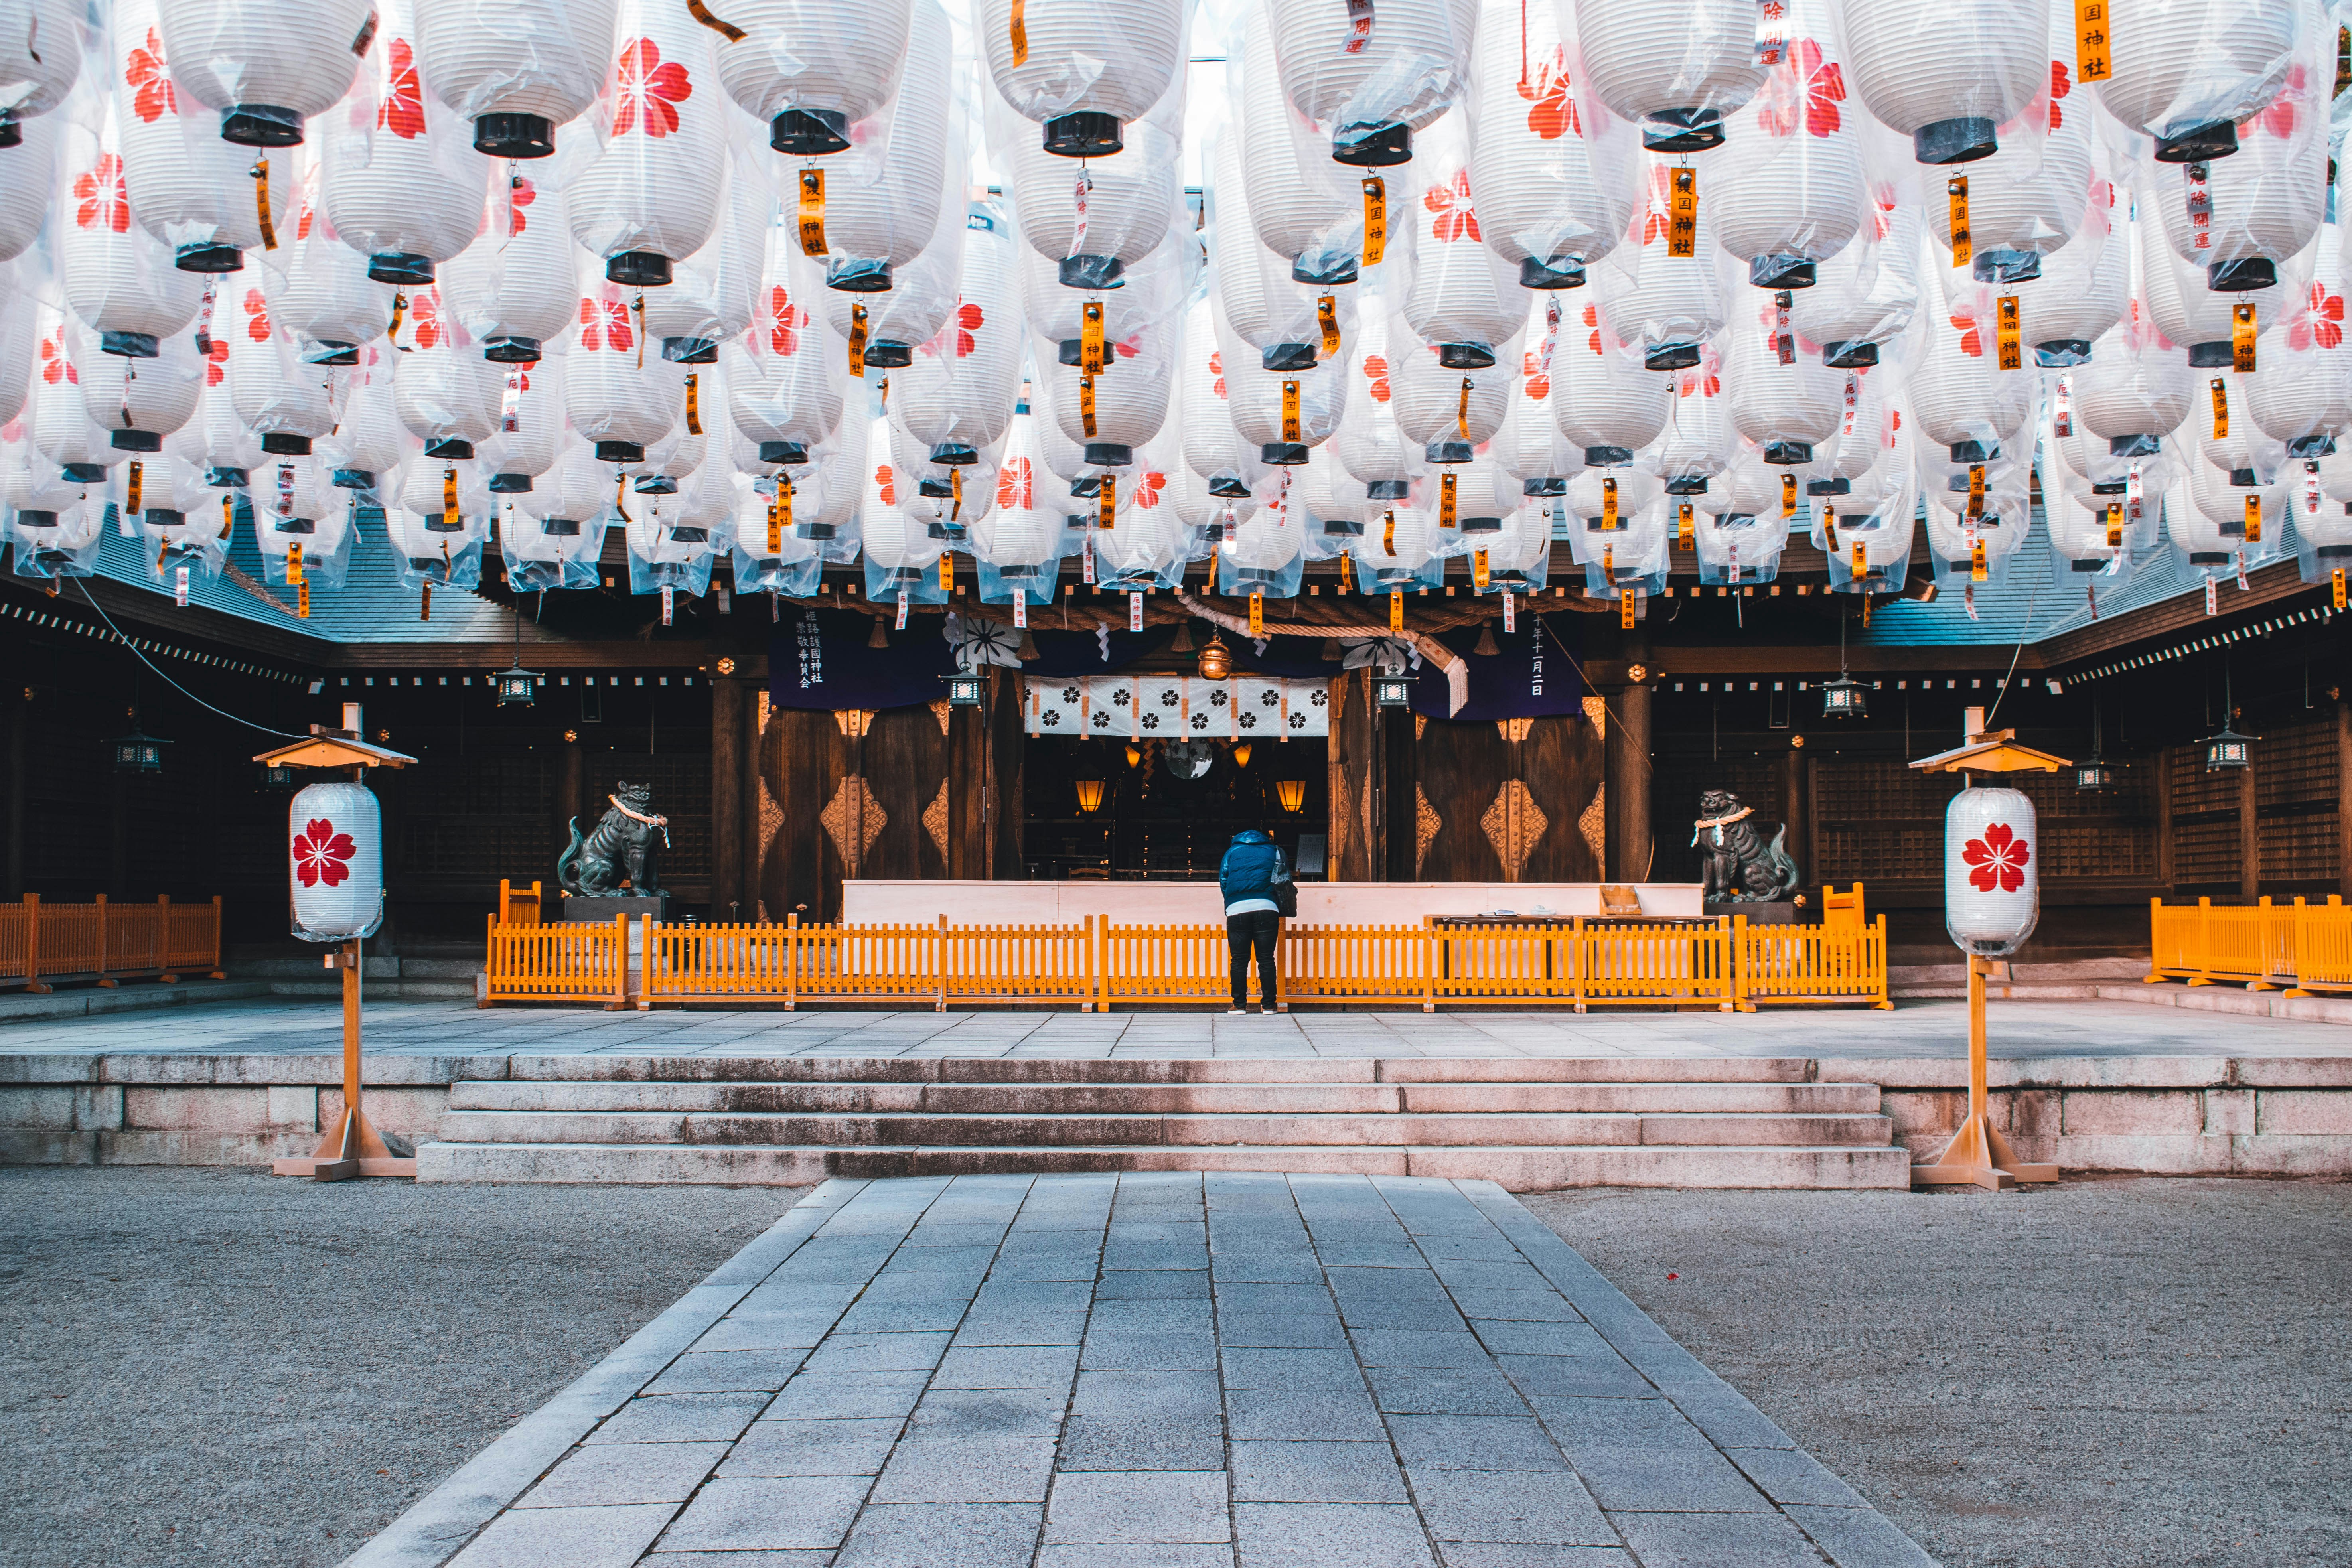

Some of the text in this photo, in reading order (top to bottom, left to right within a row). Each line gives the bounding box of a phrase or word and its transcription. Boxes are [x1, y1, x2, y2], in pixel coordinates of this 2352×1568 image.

[1758, 1, 1784, 65] 除開運
[2083, 4, 2106, 78] 国神社
[1542, 310, 1558, 370] 厄除開運
[1843, 383, 1855, 435] 厄除開運
[1225, 513, 1235, 542] 厄除開
[1531, 613, 1544, 696] 十年十一月二日
